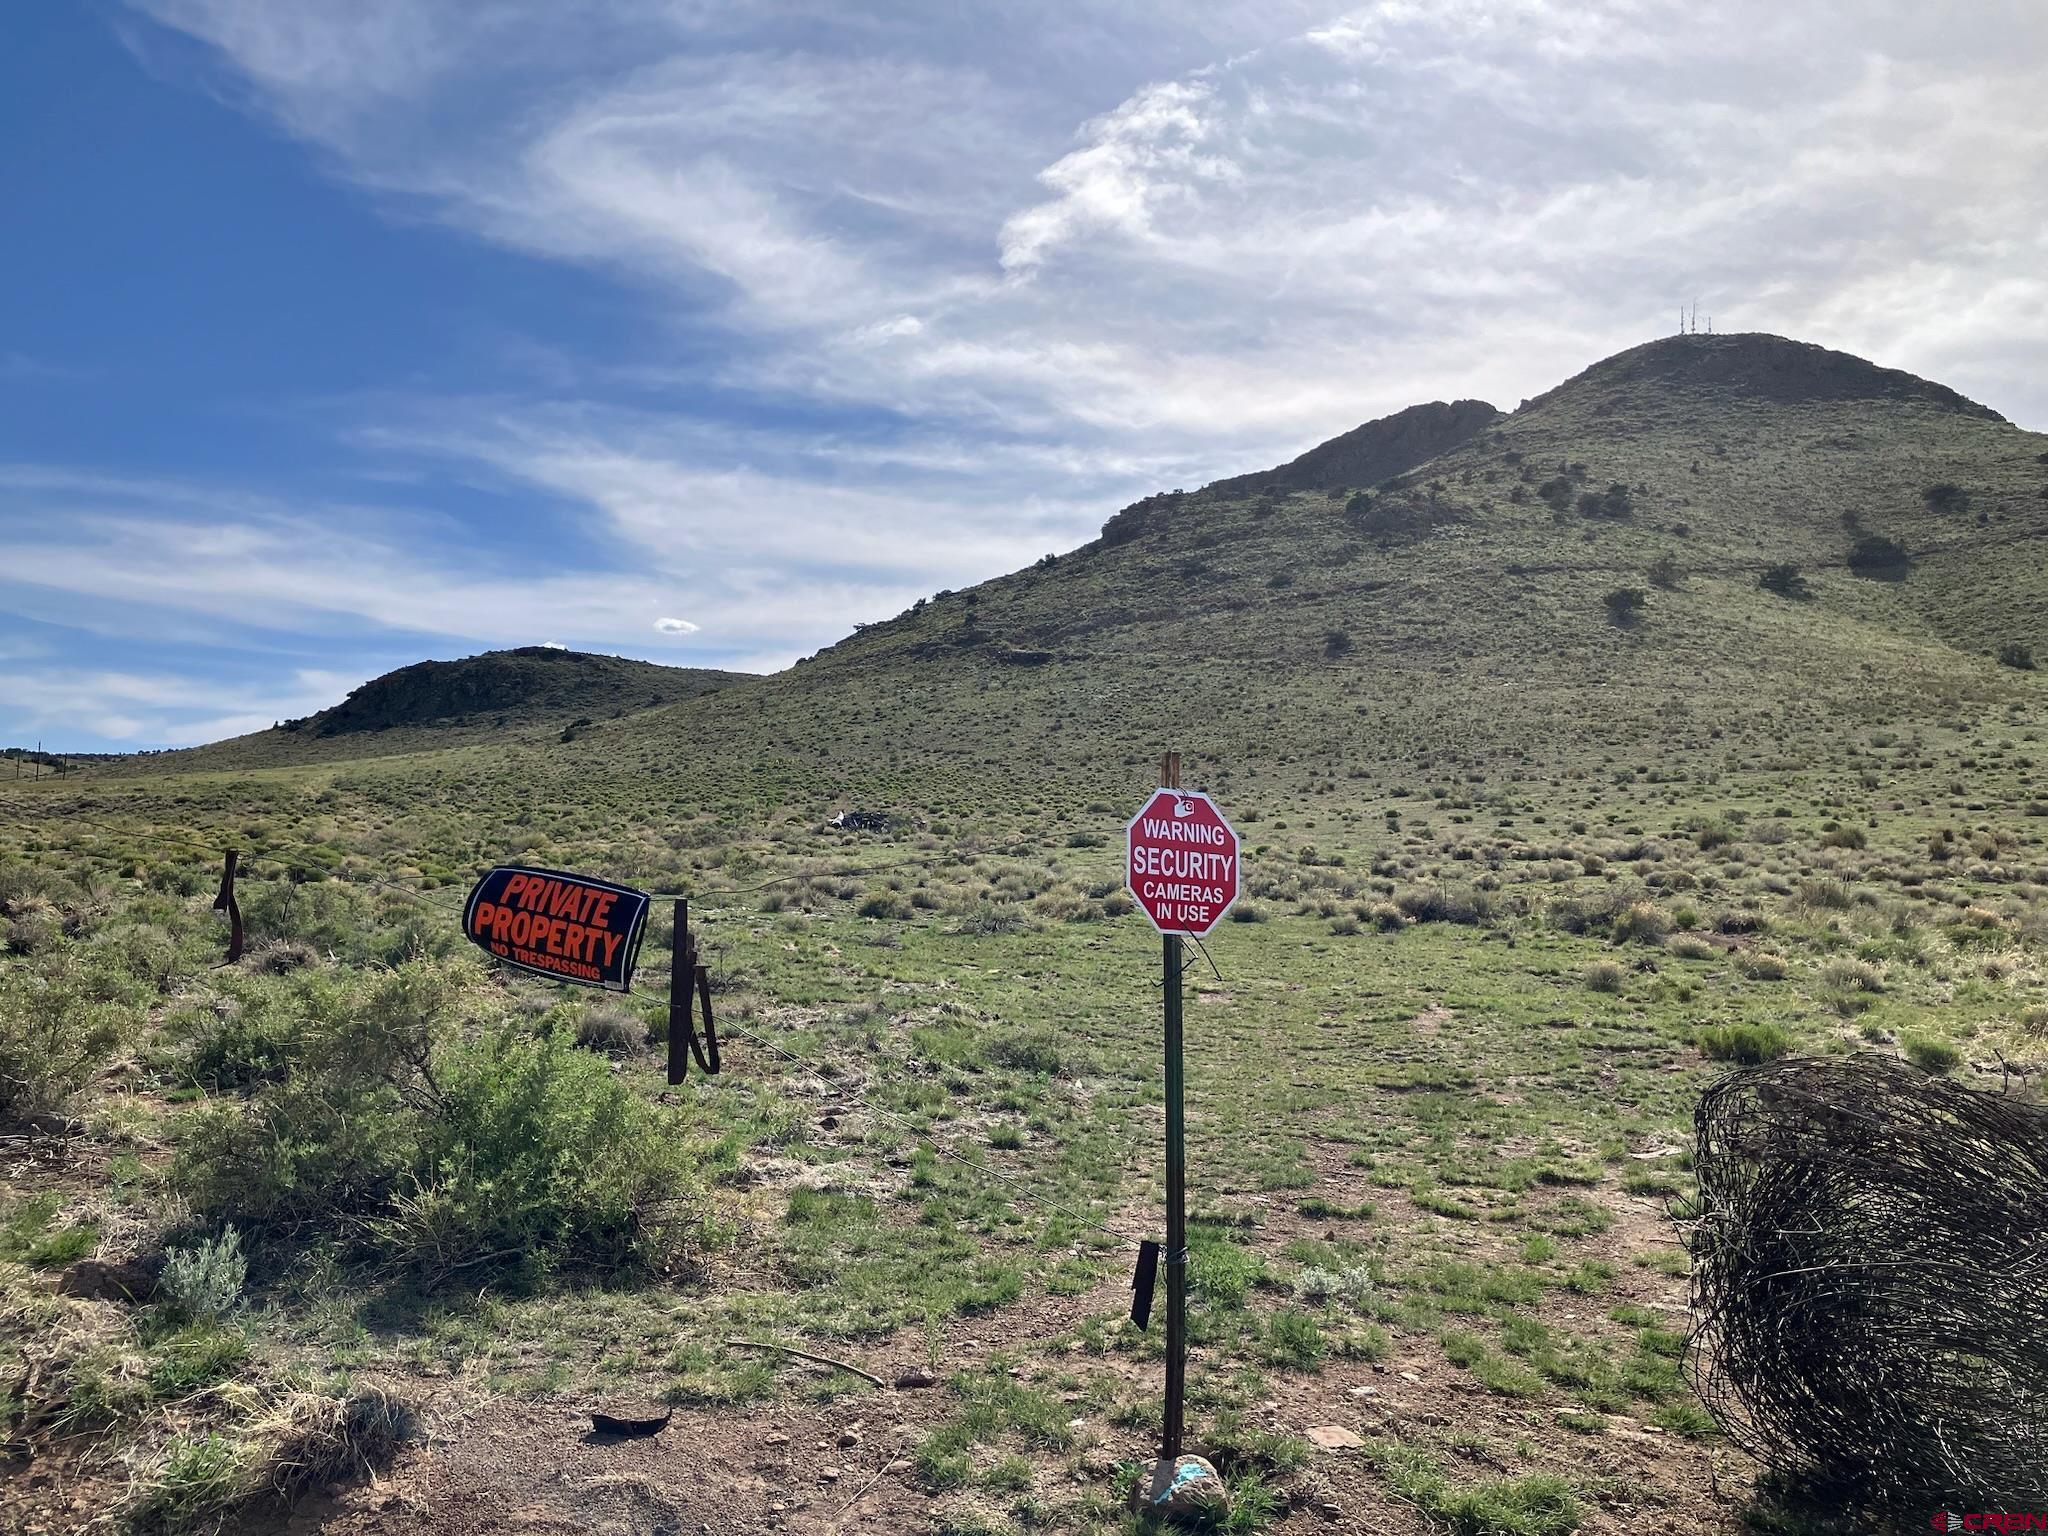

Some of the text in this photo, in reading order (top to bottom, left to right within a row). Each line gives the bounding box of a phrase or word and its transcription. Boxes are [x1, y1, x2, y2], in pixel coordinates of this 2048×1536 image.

[1143, 818, 1225, 846] WARNING
[1133, 845, 1234, 882] SECURITY
[500, 873, 620, 927] PRIVATE
[1143, 881, 1224, 904] CAMERAS
[1156, 902, 1210, 923] IN USE
[474, 902, 623, 968] PROPERTY
[490, 942, 601, 980] NO TRESPASSING
